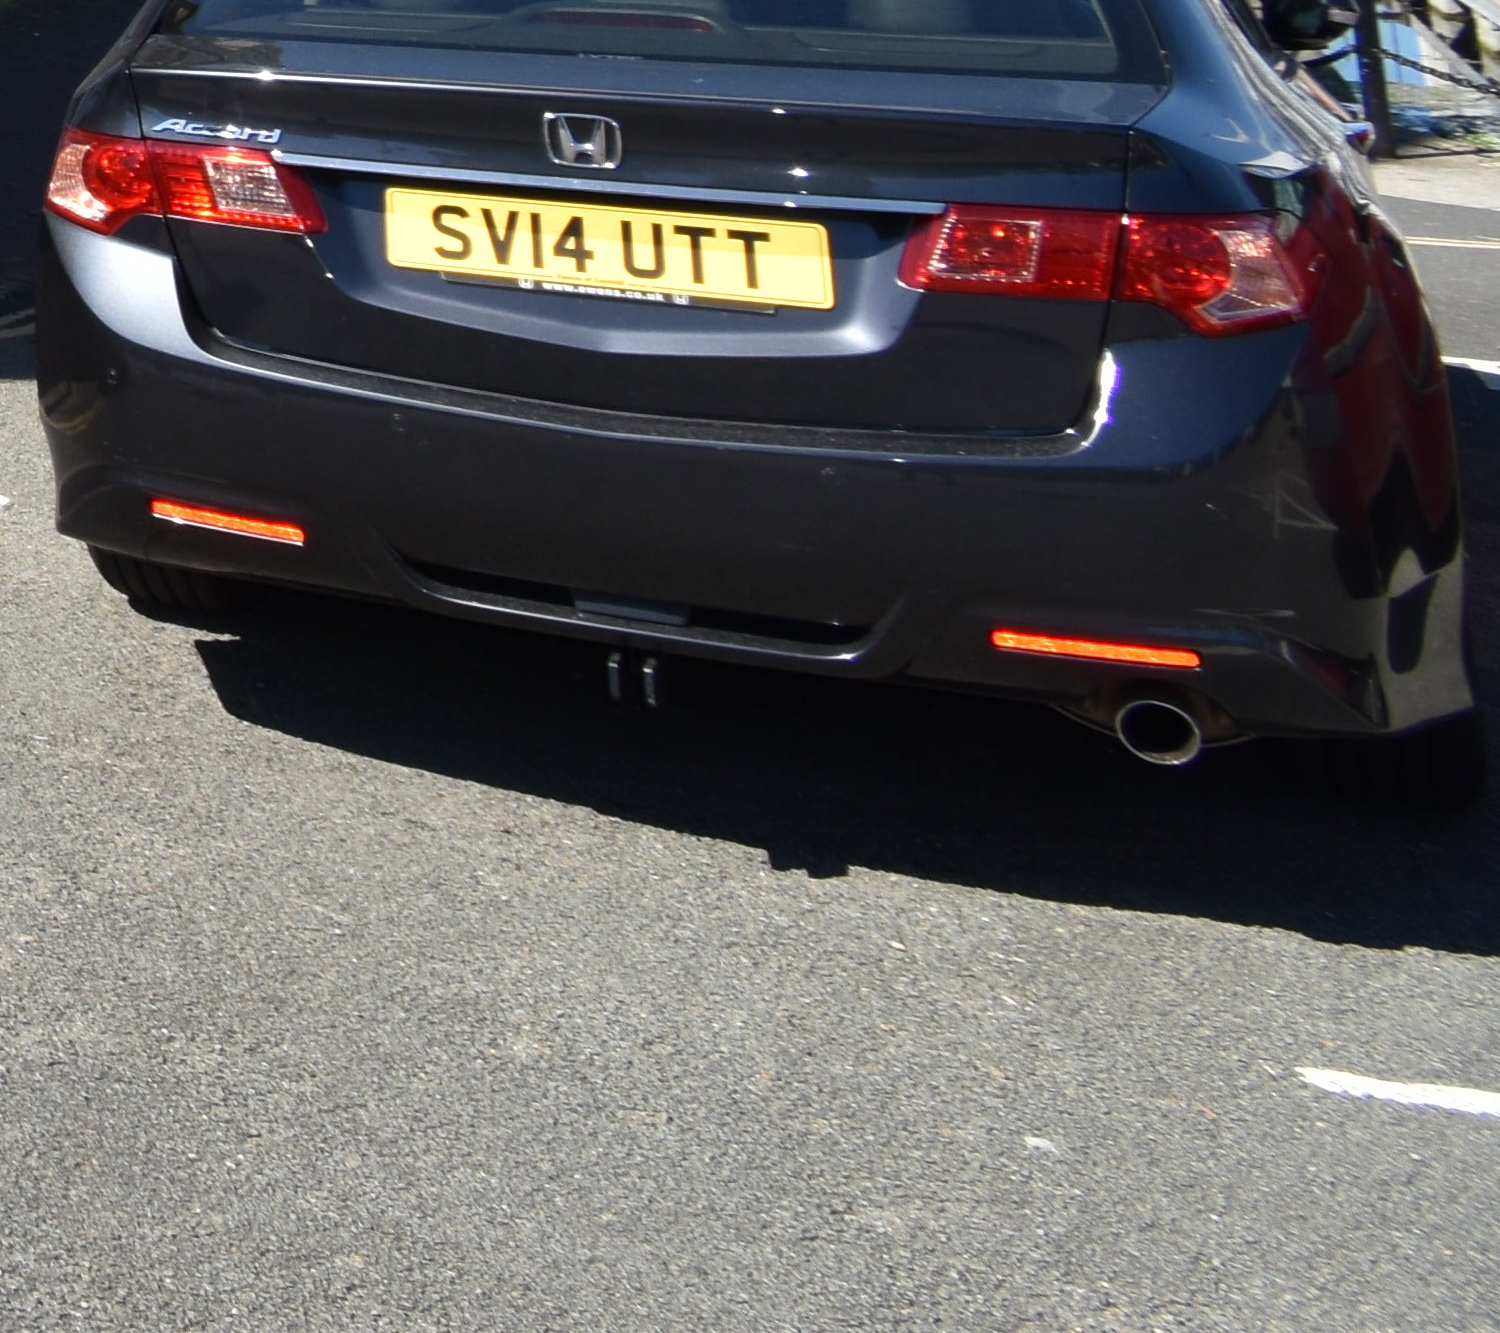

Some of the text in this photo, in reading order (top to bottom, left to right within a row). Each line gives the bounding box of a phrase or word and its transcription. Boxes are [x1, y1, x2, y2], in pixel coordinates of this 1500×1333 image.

[151, 118, 281, 144] Accord
[432, 204, 770, 289] SV14 UTT
